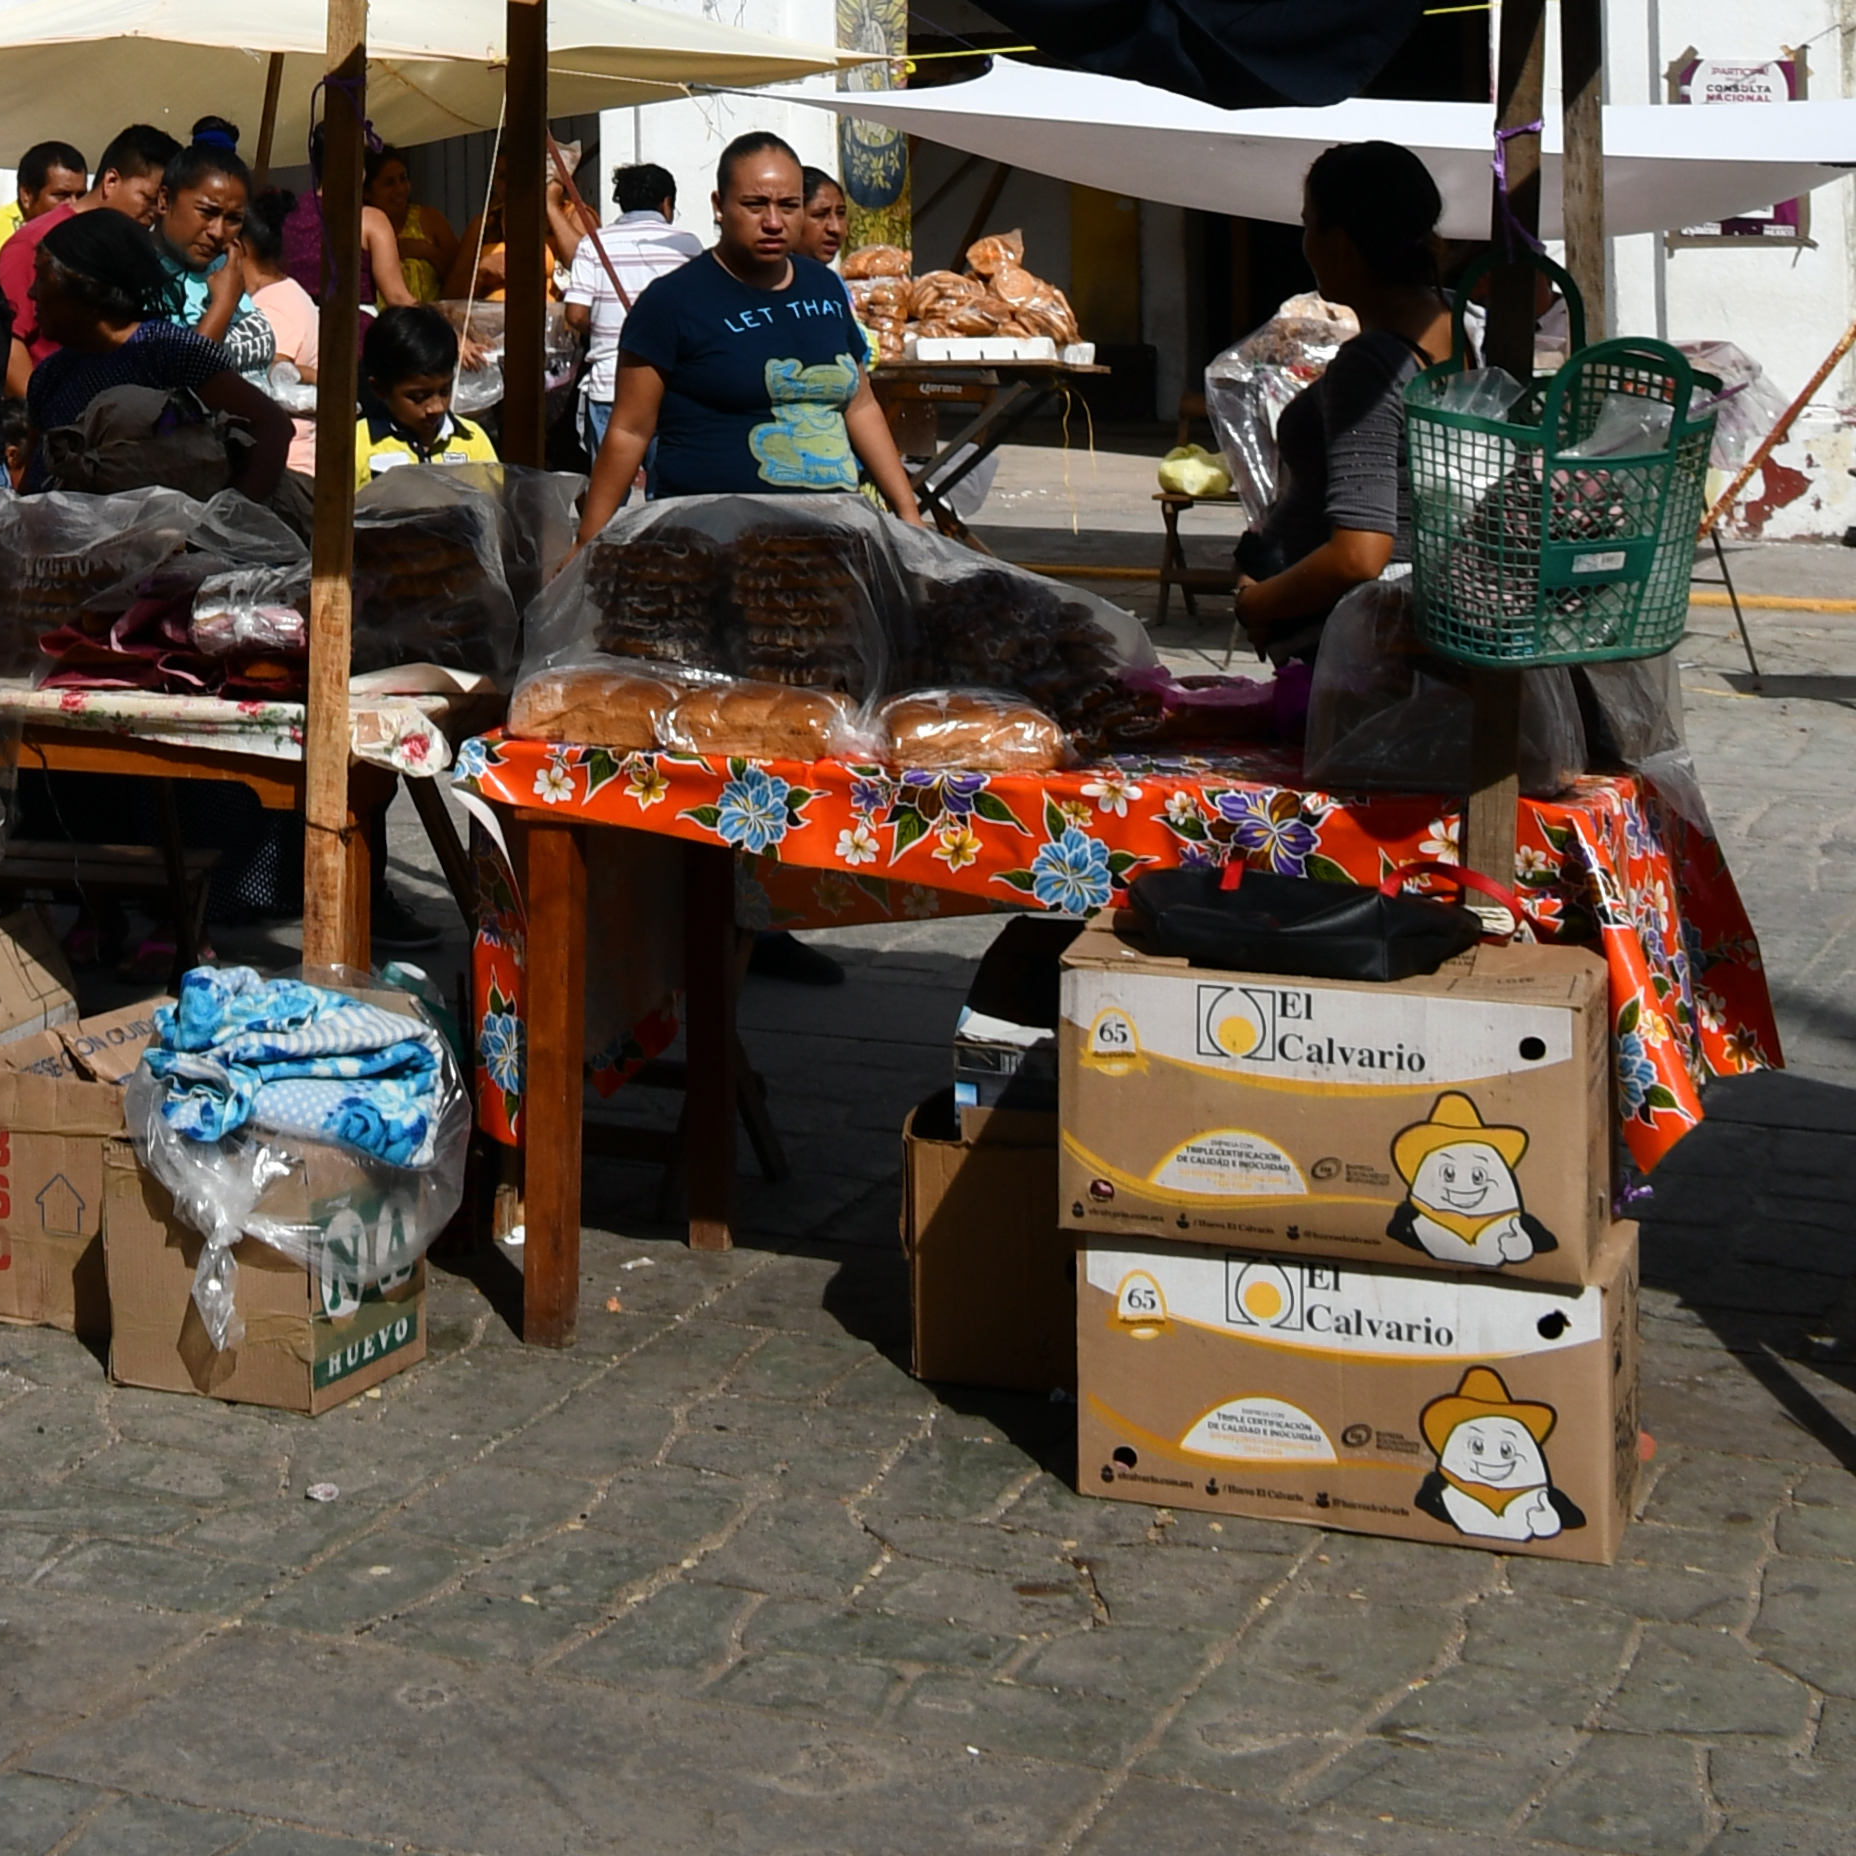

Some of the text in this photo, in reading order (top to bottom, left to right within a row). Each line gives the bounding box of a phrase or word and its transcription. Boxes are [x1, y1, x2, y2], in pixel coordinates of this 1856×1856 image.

[1706, 84, 1772, 93] CONSULTA
[1706, 93, 1772, 103] NACIONAL
[724, 299, 845, 333] LET THAT
[231, 334, 272, 365] THE
[1278, 991, 1313, 1021] El
[1099, 1021, 1128, 1044] 65
[1278, 1033, 1426, 1074] Calvario
[1176, 1154, 1187, 1163] DE
[1190, 1156, 1230, 1167] CALIDAD
[1186, 1146, 1214, 1155] TRIPLE
[328, 1207, 417, 1310] NA
[1305, 1262, 1342, 1291] El
[1127, 1288, 1157, 1311] 65
[1306, 1304, 1454, 1348] Calvario
[328, 1317, 408, 1378] HUEVO
[1207, 1421, 1219, 1430] DE
[1221, 1423, 1261, 1434] CALIDAD
[1217, 1412, 1244, 1423] TRIPLE
